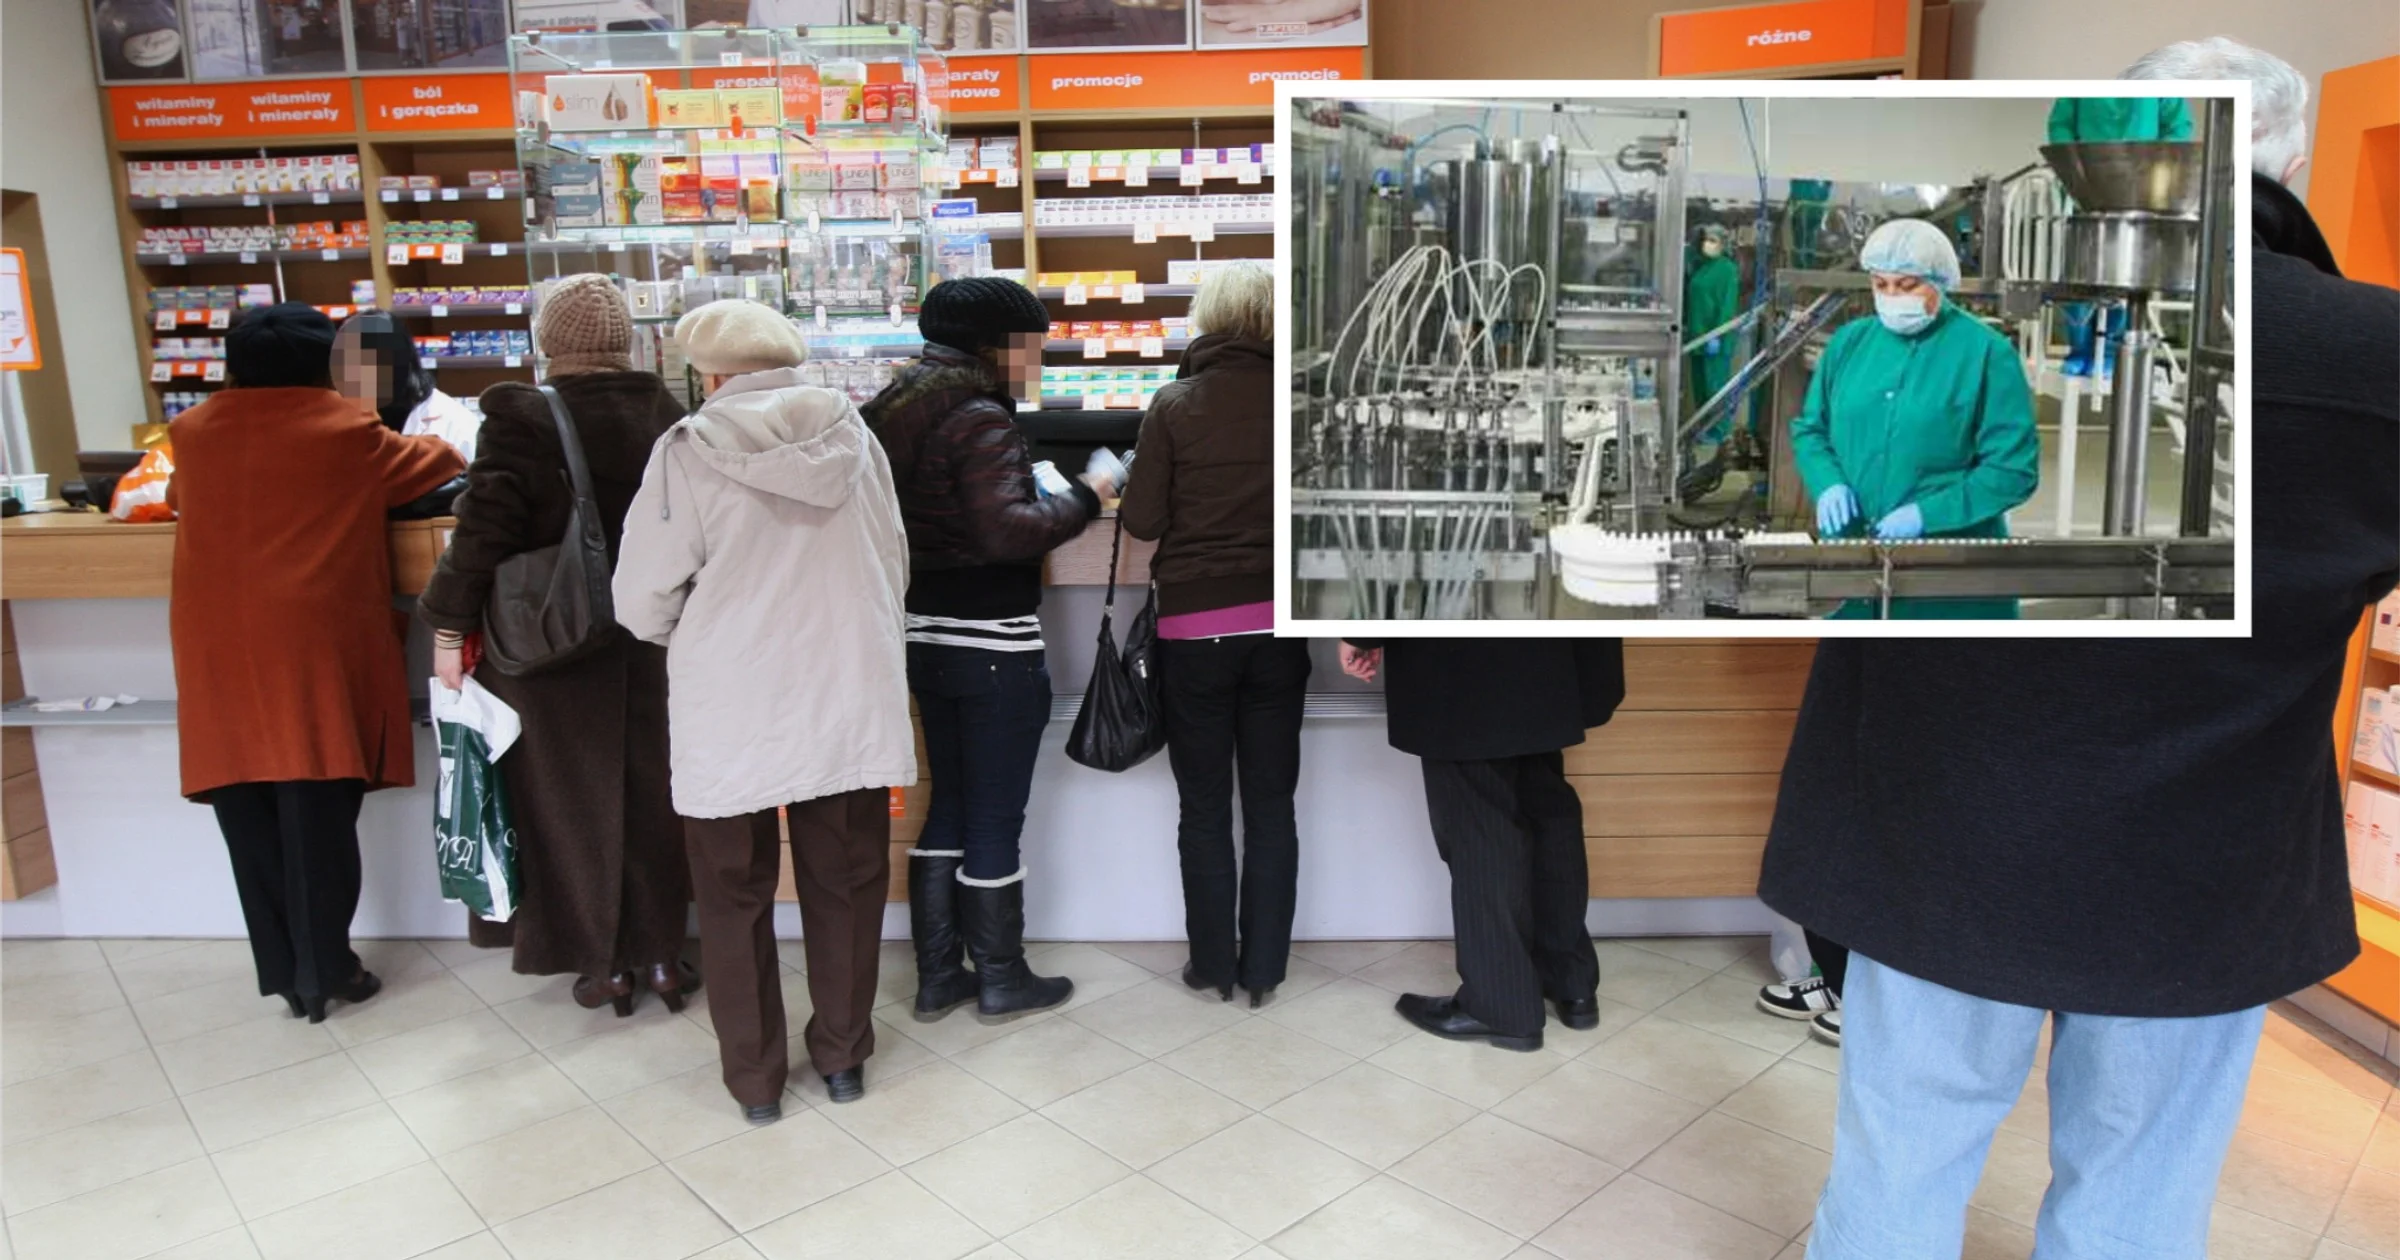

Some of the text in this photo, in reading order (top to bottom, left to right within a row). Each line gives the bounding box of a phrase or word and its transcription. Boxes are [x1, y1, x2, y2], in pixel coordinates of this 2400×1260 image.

[1747, 29, 1812, 47] różne
[1051, 73, 1143, 91] promocje
[1248, 68, 1340, 85] promocje
[251, 91, 331, 106] witaminy
[413, 85, 442, 100] ból
[136, 96, 216, 110] witaminy
[380, 102, 480, 120] i gorączka
[133, 113, 224, 127] i minerały
[248, 107, 339, 123] i minerały
